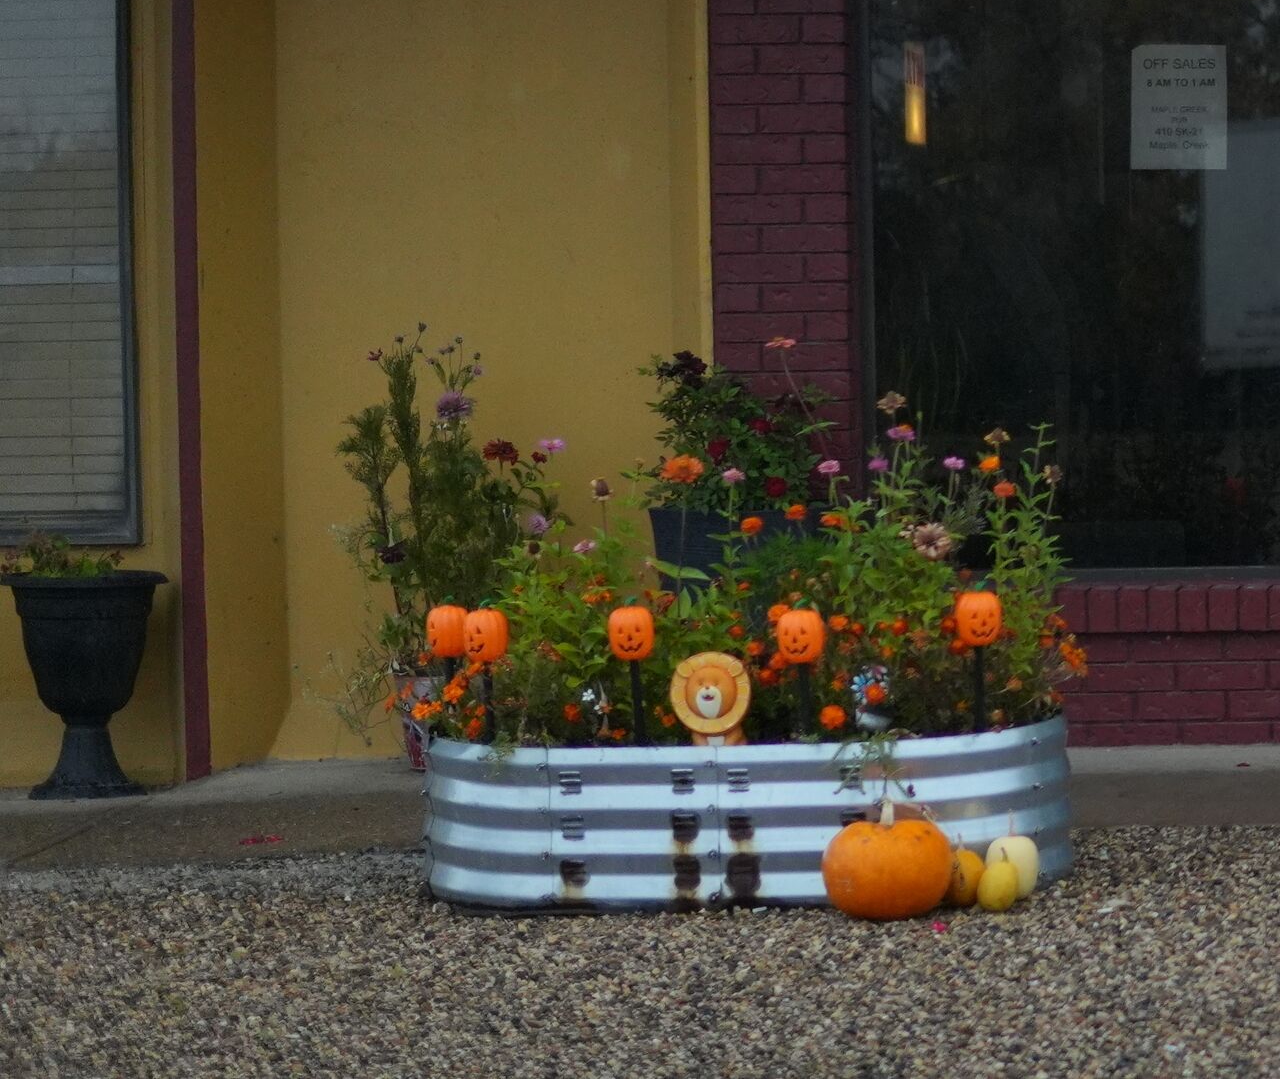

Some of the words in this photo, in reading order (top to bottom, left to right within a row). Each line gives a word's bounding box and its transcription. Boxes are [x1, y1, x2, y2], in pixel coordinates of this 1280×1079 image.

[1143, 58, 1169, 70] OFF
[1172, 57, 1216, 70] SALES
[1155, 79, 1171, 87] AM
[1173, 78, 1188, 87] TO
[1199, 78, 1216, 87] AM
